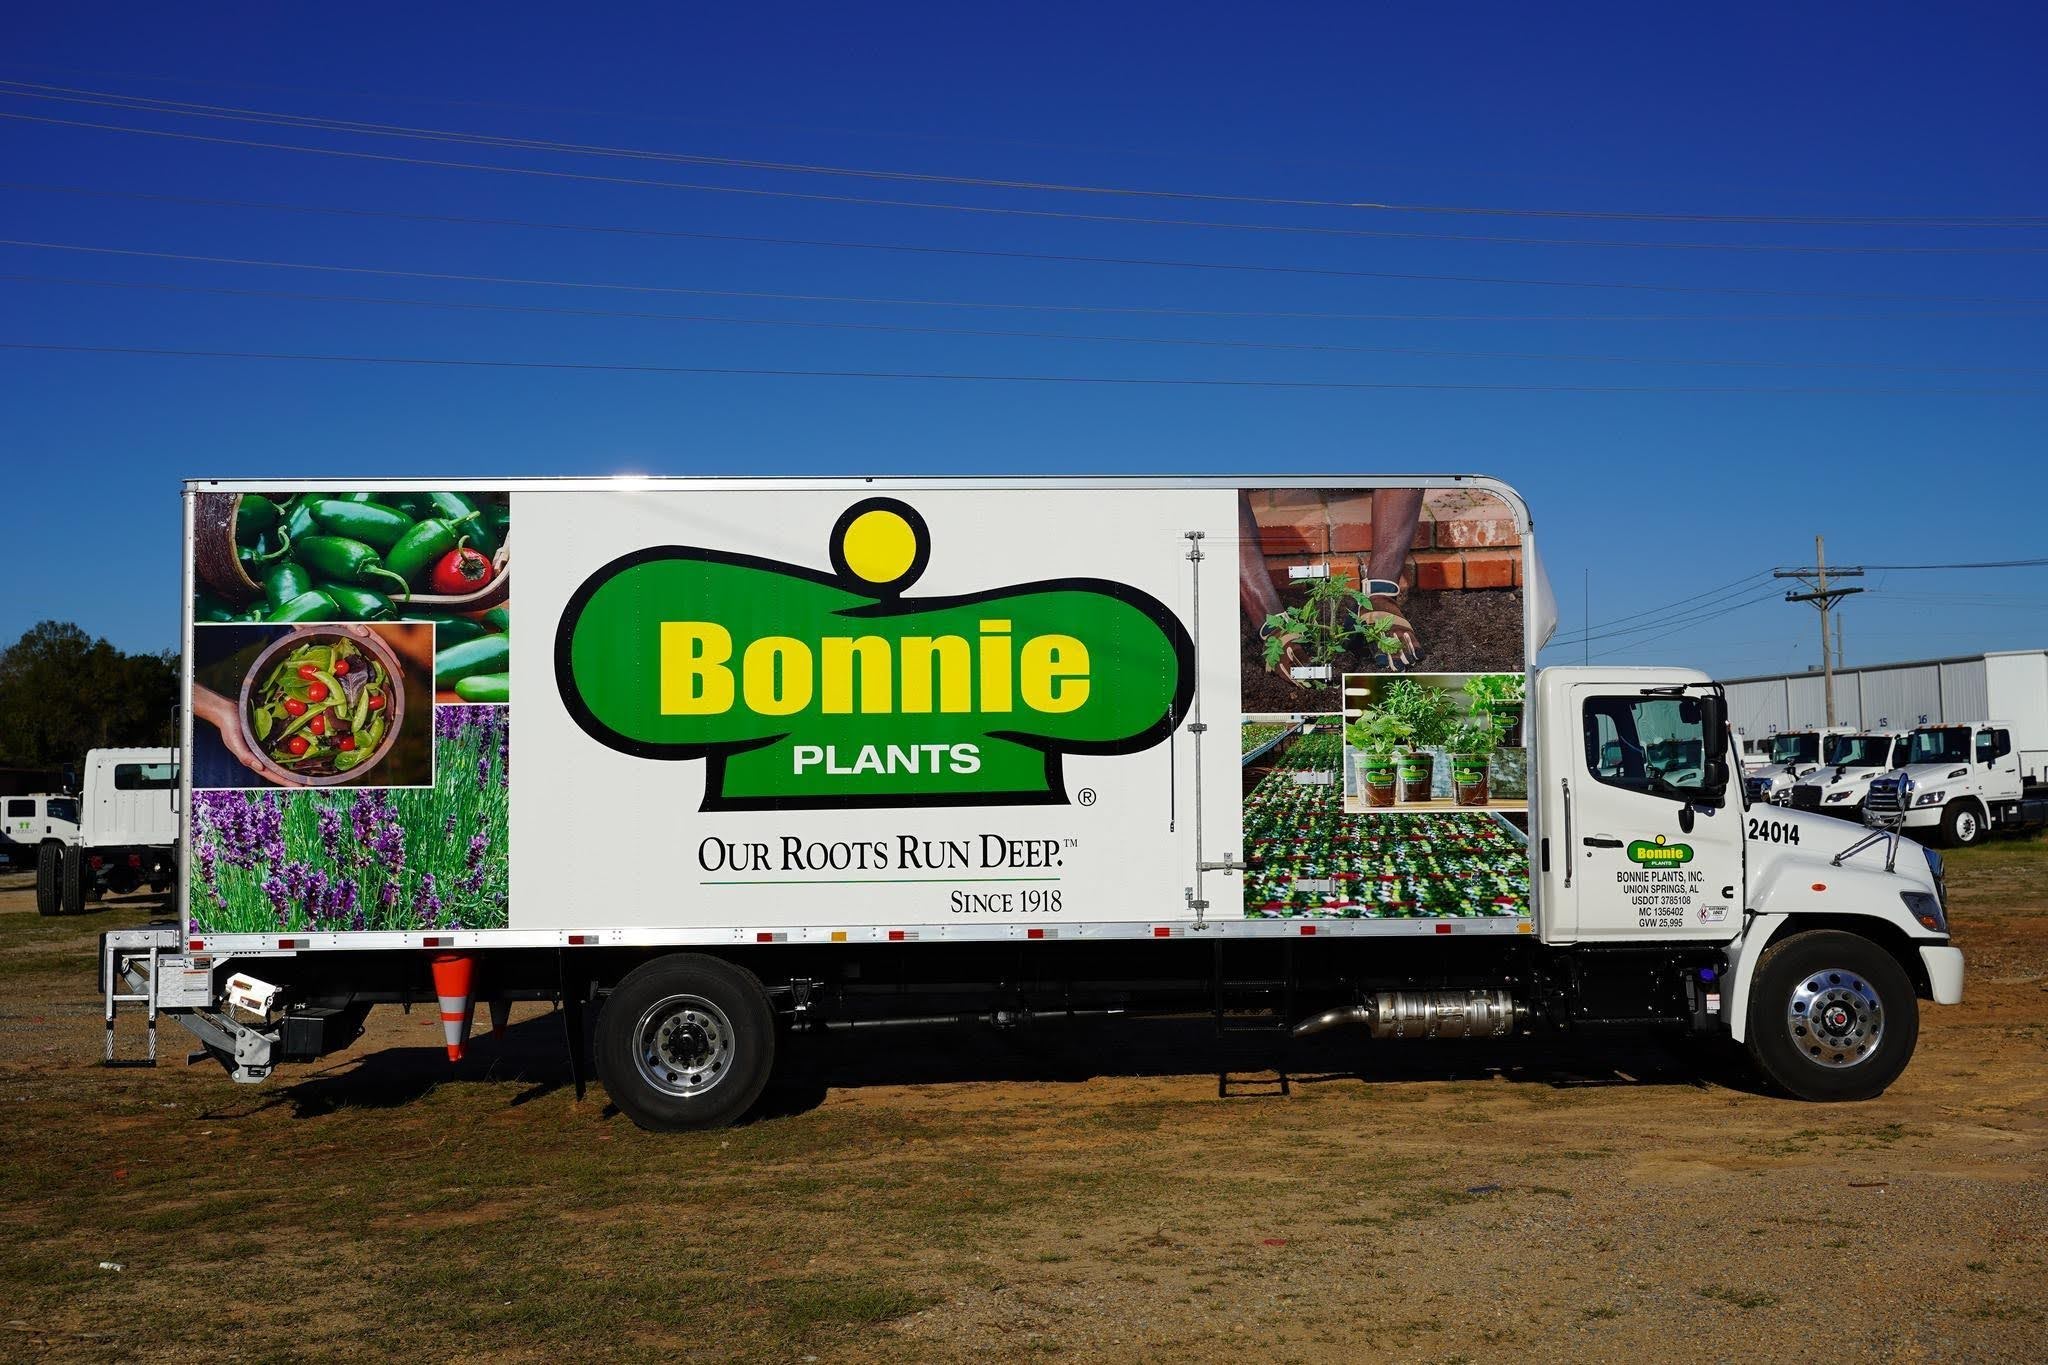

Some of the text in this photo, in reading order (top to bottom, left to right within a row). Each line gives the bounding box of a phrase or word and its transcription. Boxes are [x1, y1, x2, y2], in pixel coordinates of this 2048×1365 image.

[660, 619, 1090, 716] Bonnie
[1879, 717, 1888, 727] 15
[1918, 714, 1927, 724] 16
[1768, 723, 1777, 733] 12
[793, 743, 981, 775] PLANTS
[1747, 818, 1800, 846] 24014
[1637, 847, 1684, 859] Bonnie
[1616, 871, 1705, 884] BONNIE PLANTS, INC.
[1623, 885, 1699, 895] UNION SPRINGS, AL
[1020, 889, 1062, 913] 1918
[1631, 896, 1691, 905] USDOT 3785108
[1639, 907, 1684, 917] MC 1356402
[1639, 918, 1683, 928] GVW 25,995
